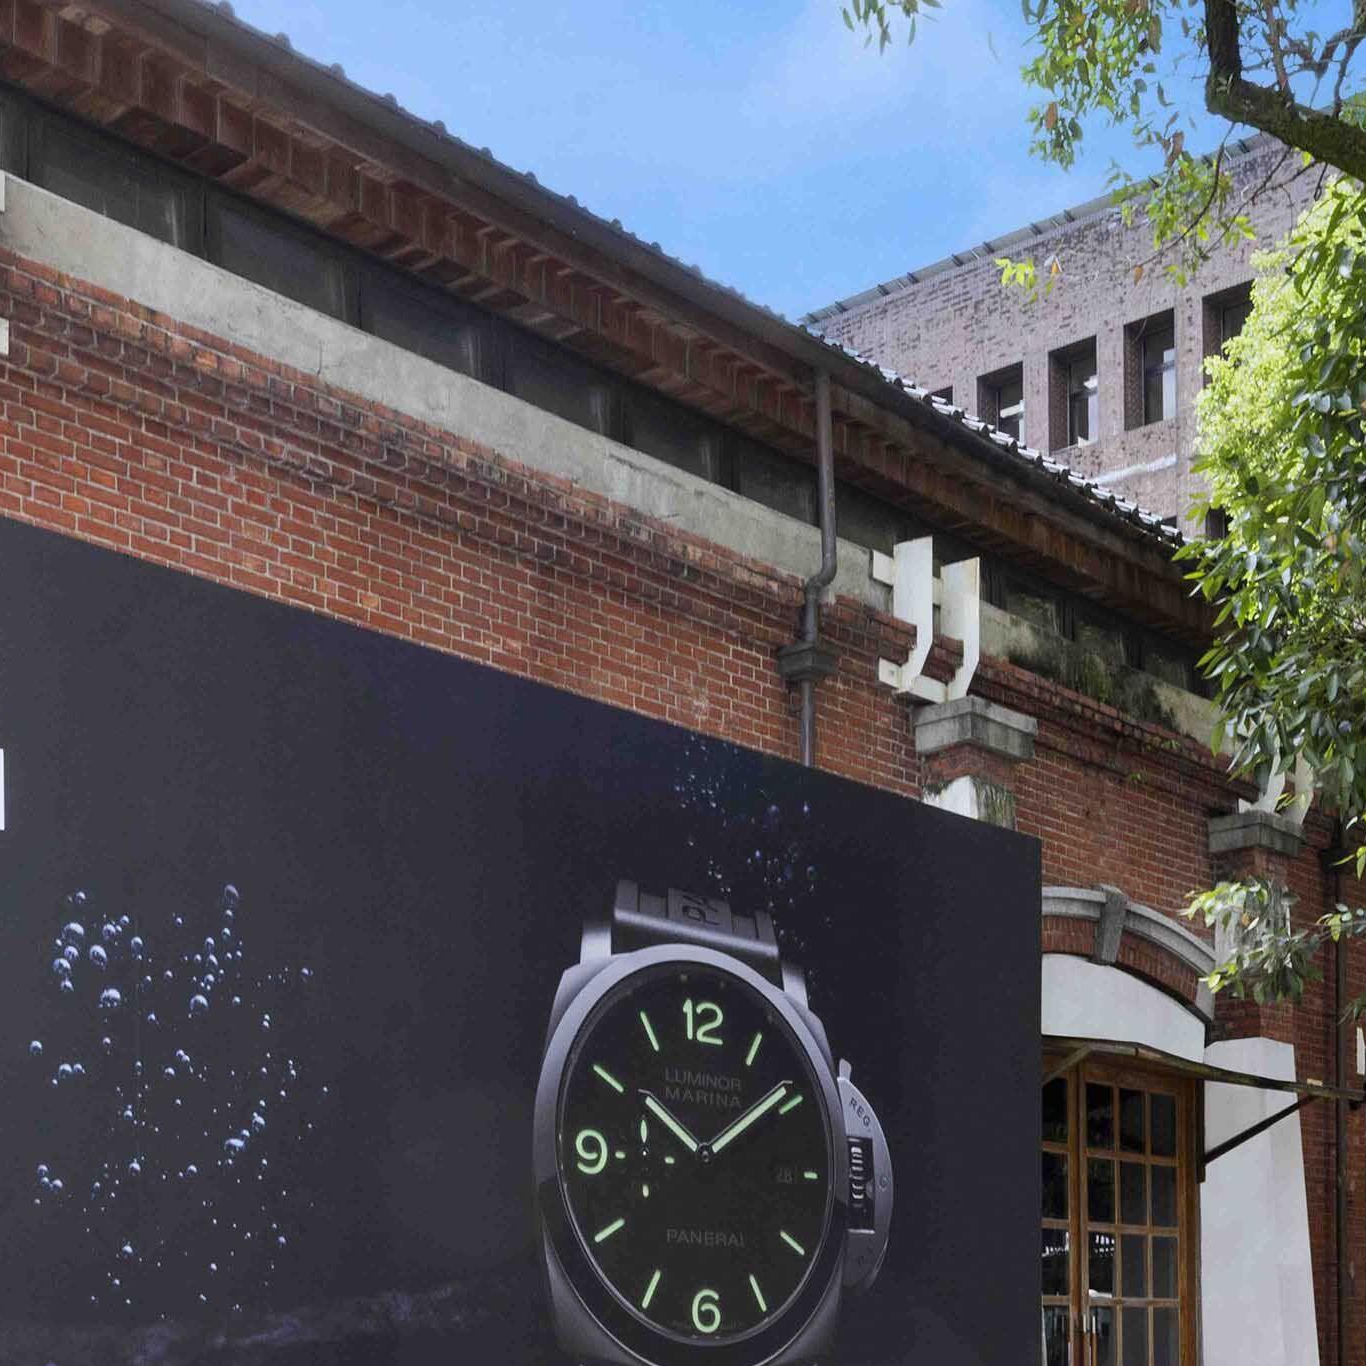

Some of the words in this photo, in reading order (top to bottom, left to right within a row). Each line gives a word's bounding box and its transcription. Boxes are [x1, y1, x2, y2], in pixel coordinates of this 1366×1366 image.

[682, 997, 724, 1045] 12
[664, 1067, 743, 1092] LUMINOR
[665, 1087, 742, 1109] MARINA
[575, 1129, 608, 1175] 9
[665, 1227, 747, 1249] PANERAI
[691, 1289, 722, 1334] 6
